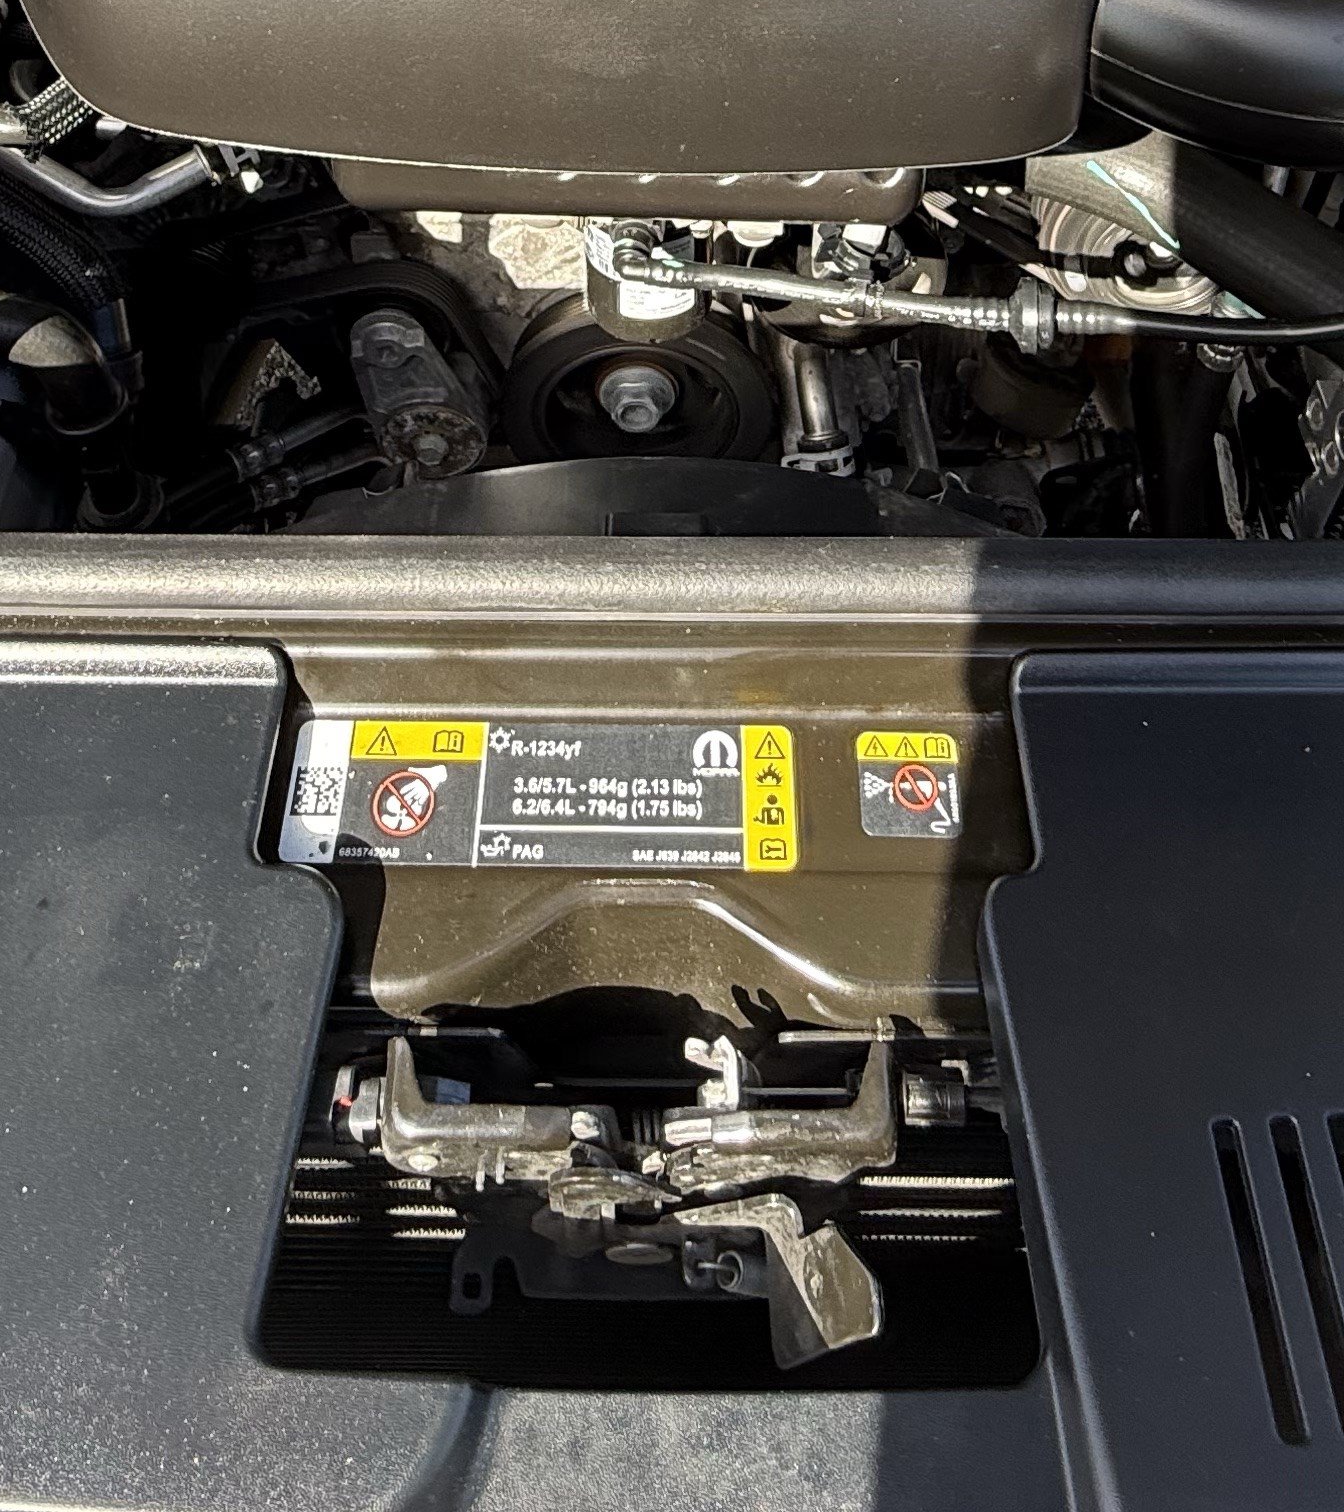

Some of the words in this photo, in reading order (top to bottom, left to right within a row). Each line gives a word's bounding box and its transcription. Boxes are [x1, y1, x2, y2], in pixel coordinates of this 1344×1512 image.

[511, 740, 582, 760] R-1234yf
[513, 777, 577, 794] 3.6/5.7L
[588, 777, 628, 797] 964g
[631, 778, 670, 798] (2.13
[672, 778, 703, 798] lbs)
[512, 798, 576, 816] 6.2/6.4L
[587, 798, 628, 819] 794g
[631, 799, 670, 820] (1.75
[672, 799, 703, 820] lbs)
[512, 844, 544, 859] PAG
[632, 849, 654, 862] SAE
